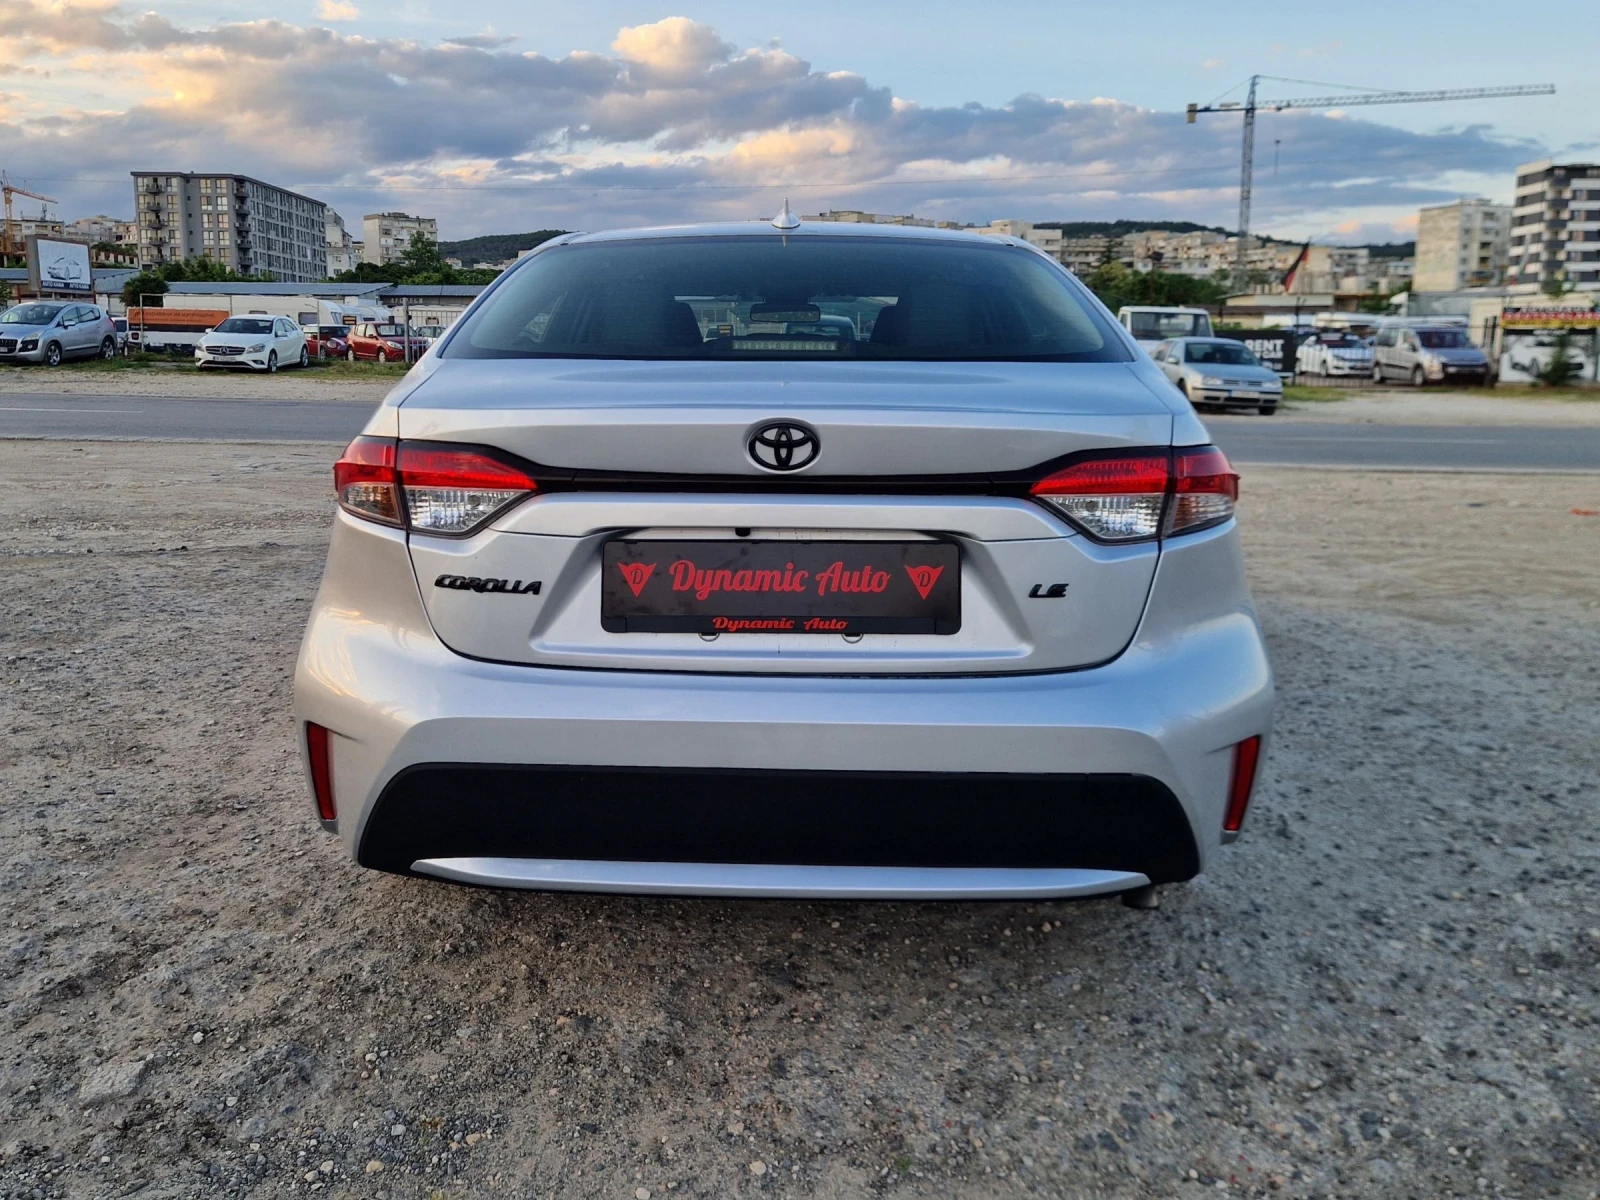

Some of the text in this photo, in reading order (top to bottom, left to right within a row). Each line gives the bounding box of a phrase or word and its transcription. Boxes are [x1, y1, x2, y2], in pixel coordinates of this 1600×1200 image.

[1245, 339, 1284, 351] RENT
[434, 574, 542, 595] COROLLA
[669, 560, 891, 600] Dynamic Auto
[1028, 583, 1069, 598] LE
[712, 616, 848, 632] Dynamic Auto
